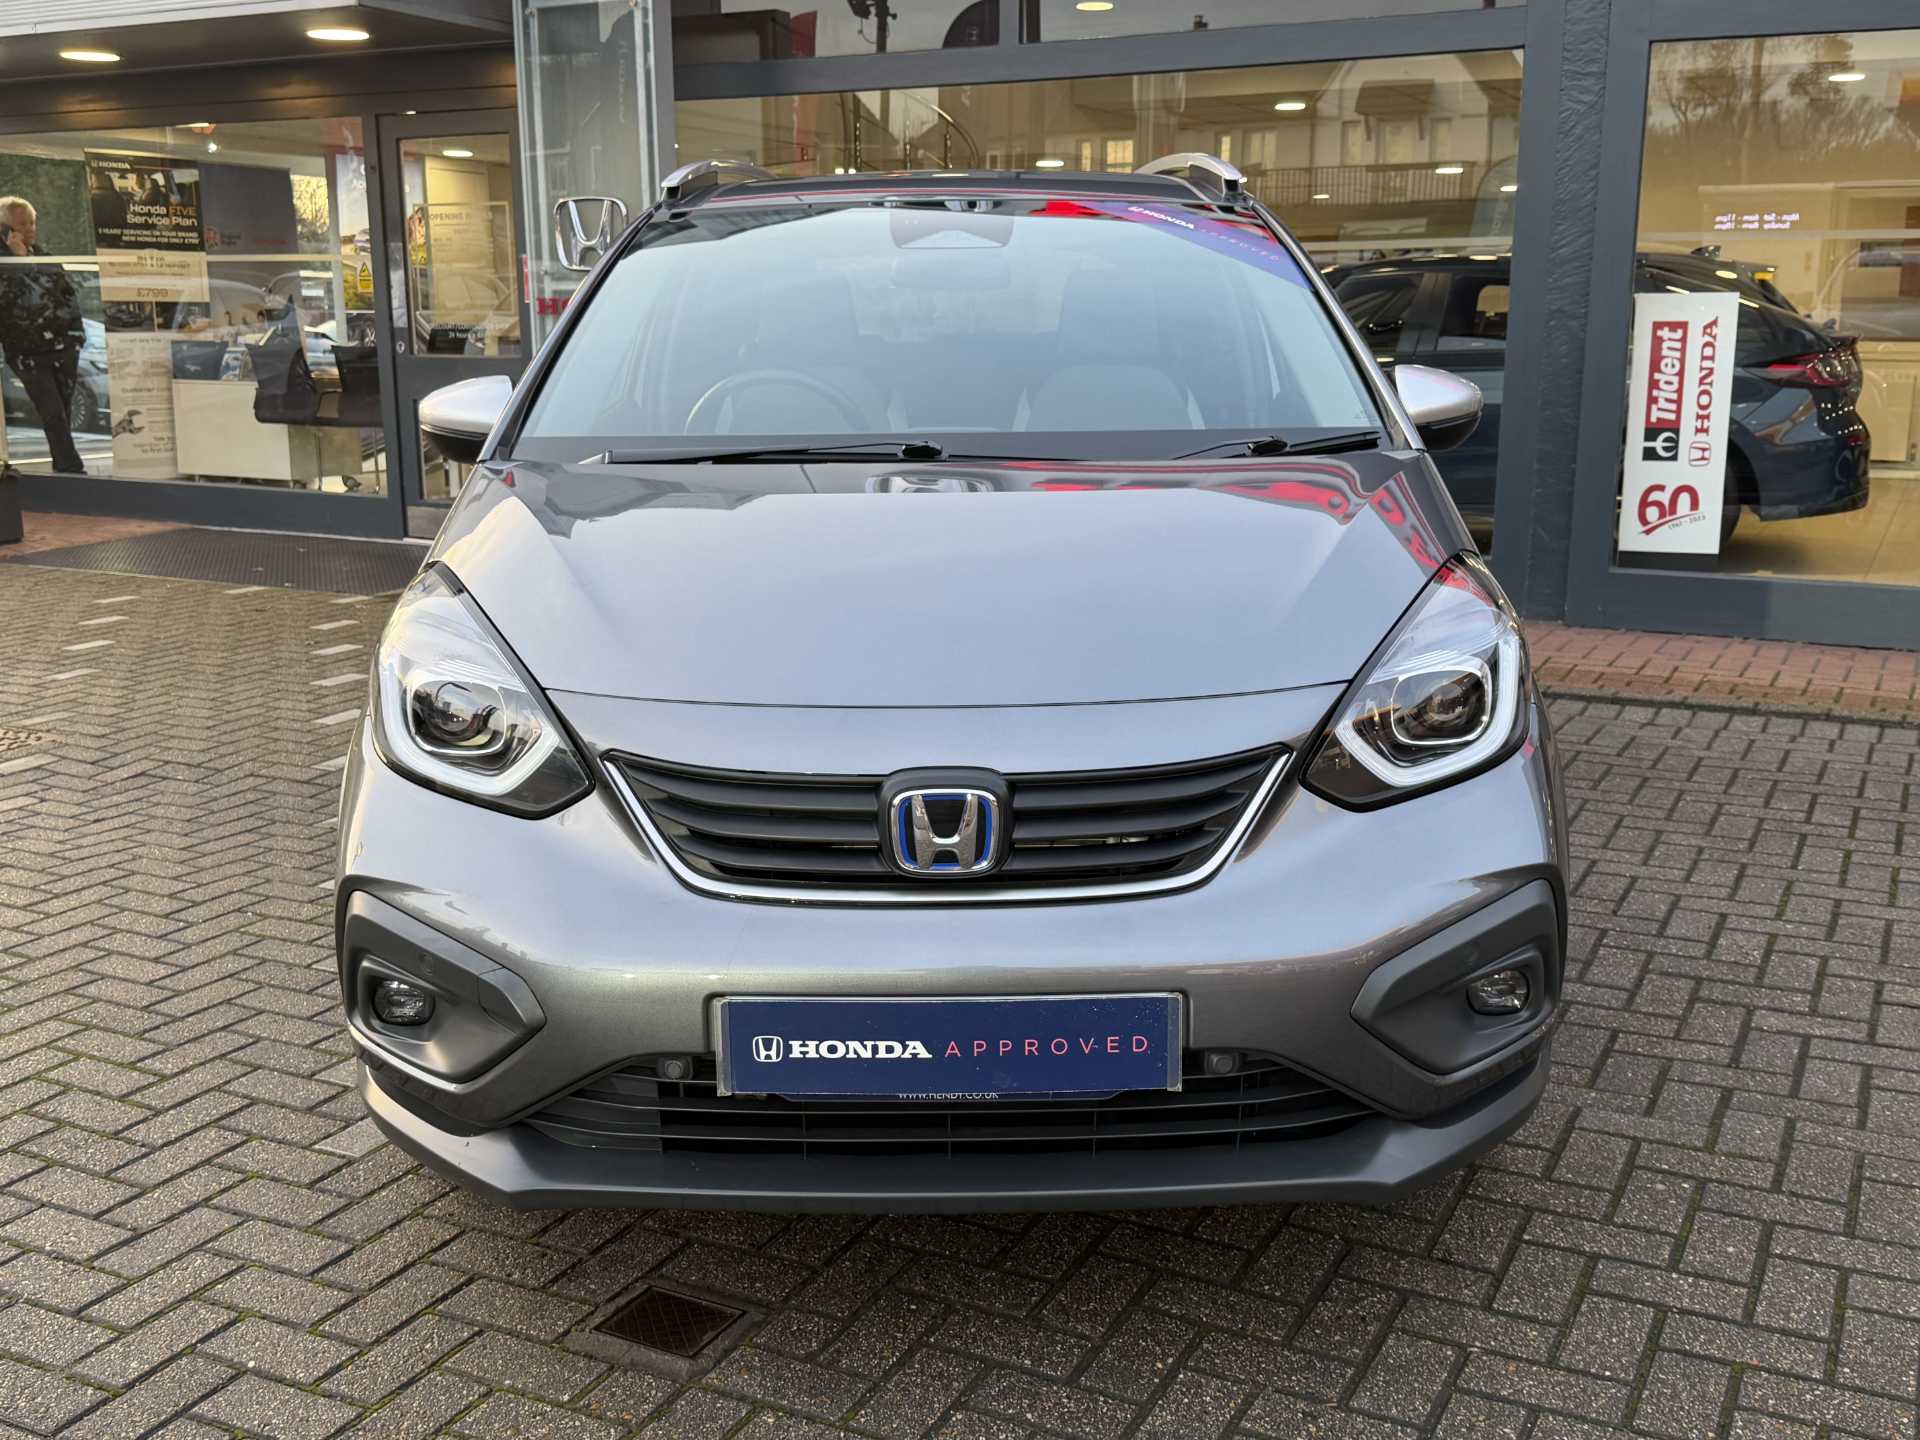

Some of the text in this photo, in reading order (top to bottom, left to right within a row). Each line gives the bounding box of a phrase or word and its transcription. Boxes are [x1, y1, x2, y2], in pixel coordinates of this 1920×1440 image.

[99, 161, 130, 169] HONDA
[126, 214, 197, 226] Service Plan
[129, 203, 196, 216] Honda FIVE
[1143, 209, 1195, 229] HONDA
[1650, 326, 1683, 423] Trident
[1695, 316, 1719, 436] HONDA
[1637, 484, 1700, 528] 60
[788, 1036, 1149, 1058] HONDA APPROVED
